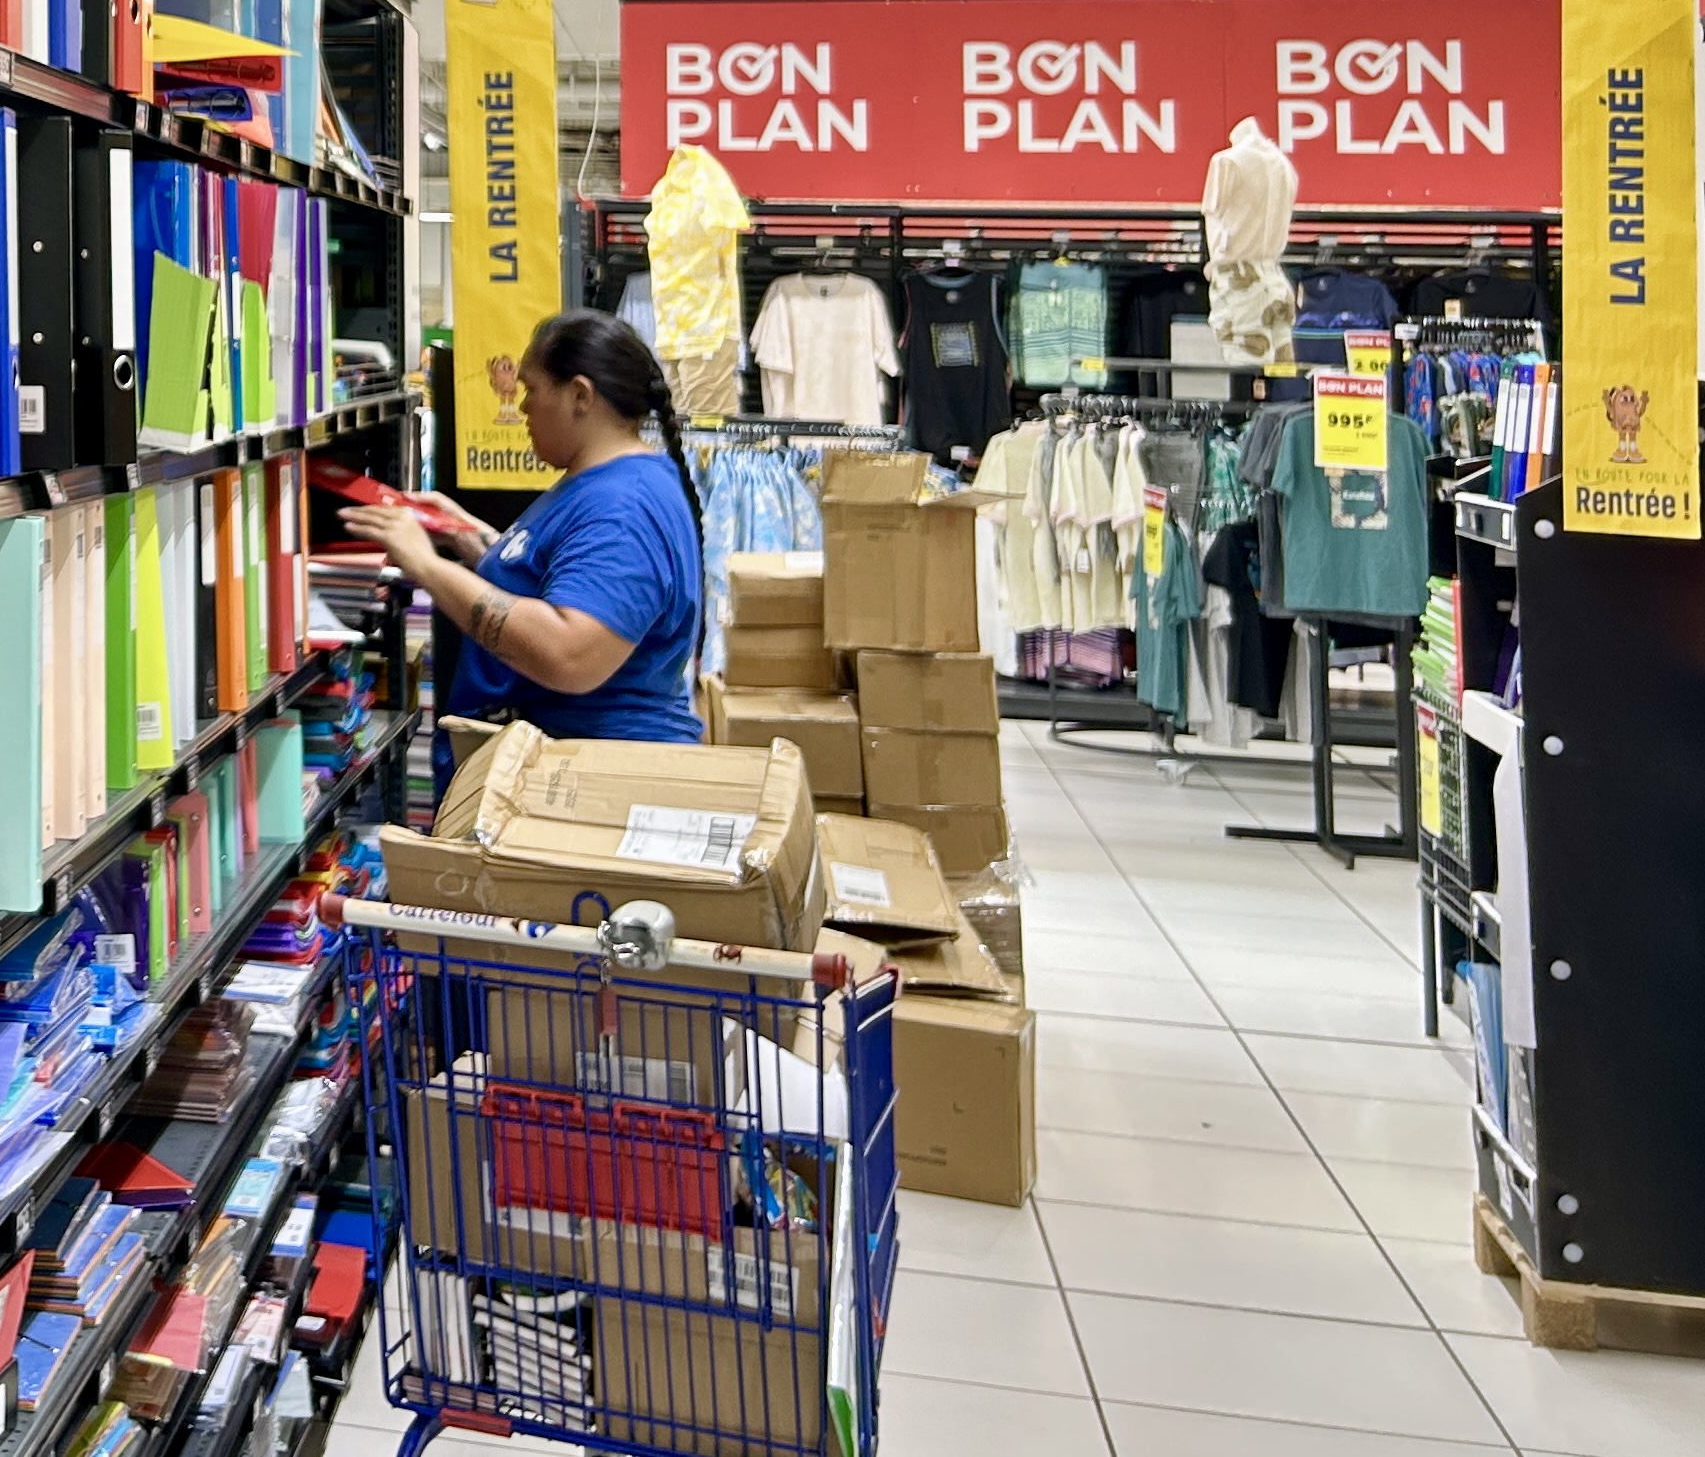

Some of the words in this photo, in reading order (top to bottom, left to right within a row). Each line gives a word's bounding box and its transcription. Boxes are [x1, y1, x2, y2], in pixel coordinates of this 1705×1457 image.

[666, 41, 833, 97] BON
[962, 39, 1139, 96] BON
[1275, 38, 1465, 96] BON
[477, 70, 518, 228] RENTRÉE
[666, 98, 870, 153] PLAN
[962, 98, 1178, 154] PLAN
[1277, 99, 1507, 156] PLAN
[1599, 67, 1646, 244] RENTRÉE
[489, 240, 519, 283] LA
[1608, 257, 1646, 306] LA
[1348, 381, 1383, 397] PLAN
[1576, 486, 1676, 519] Rentrée
[1682, 491, 1690, 520] !
